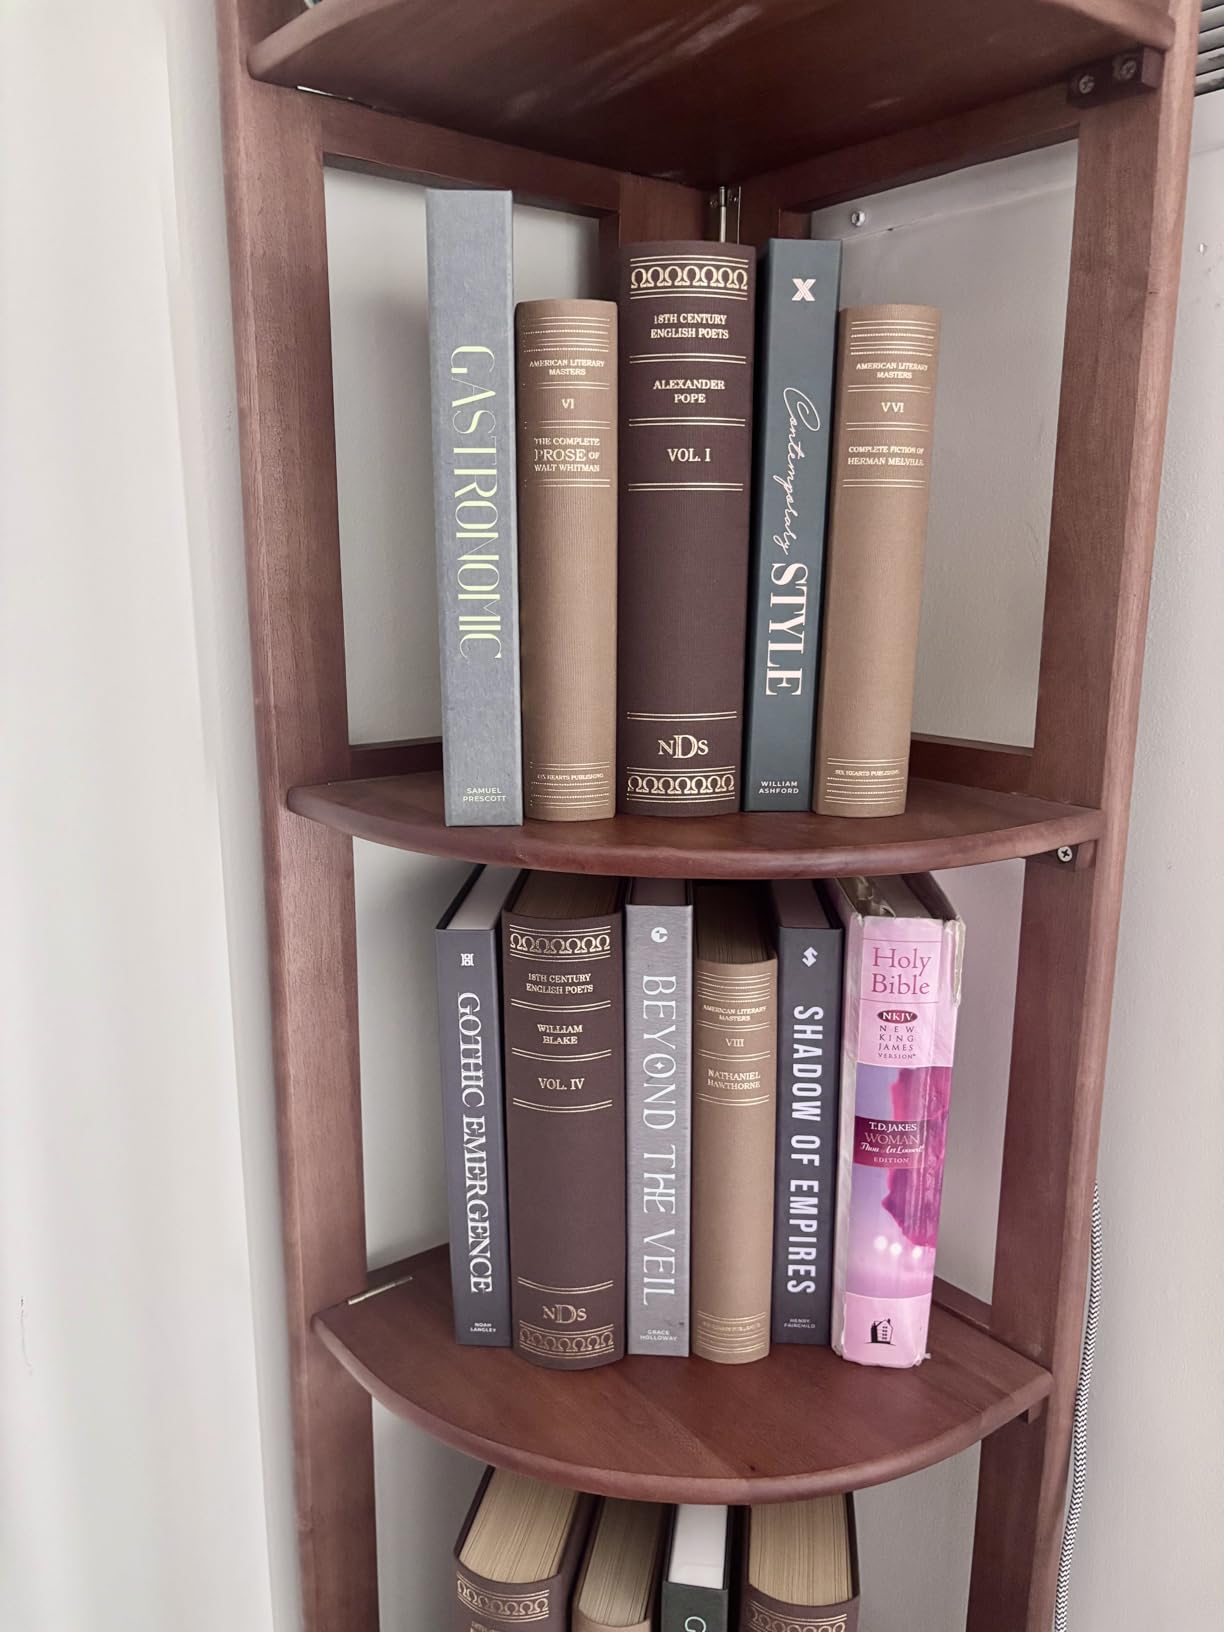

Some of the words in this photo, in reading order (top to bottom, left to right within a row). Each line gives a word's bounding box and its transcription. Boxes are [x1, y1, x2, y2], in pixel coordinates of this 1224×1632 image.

[653, 313, 678, 325] 18TH
[679, 313, 727, 325] CENTURY
[650, 328, 696, 339] ENGLISH
[698, 328, 729, 339] POETS
[529, 359, 568, 367] AMERICAN
[570, 359, 605, 367] LITERARY
[856, 362, 896, 370] AMERICAN
[548, 368, 587, 376] MASTERS
[653, 379, 725, 390] ALEXANDER
[561, 398, 575, 409] VI
[674, 393, 706, 404] POPE
[534, 437, 551, 446] THE
[552, 437, 601, 446] COMPLETE
[534, 448, 586, 462] PROSE
[588, 451, 600, 460] OF
[667, 448, 701, 462] VOL.
[705, 448, 711, 462] I
[889, 446, 916, 454] FICTION
[847, 457, 886, 465] HERMAN
[534, 463, 558, 472] WALT
[558, 463, 600, 472] WHITMAN
[771, 386, 821, 556] Contemporary
[450, 345, 502, 660] GASTRONOMIC
[765, 562, 809, 696] STYLE
[871, 947, 932, 978] Holy
[528, 973, 547, 983] 18TH
[549, 973, 591, 983] CENTURY
[526, 982, 563, 994] ENGLISH
[564, 984, 594, 994] POETS
[871, 973, 931, 996] Bible
[703, 1004, 736, 1015] AMERICAN
[736, 1006, 767, 1015] LITERARY
[718, 1014, 751, 1022] MASTERS
[882, 1012, 914, 1022] NKJV
[537, 1023, 583, 1034] WILLIAM
[879, 1025, 915, 1033] NEW
[542, 1035, 578, 1044] BLAKE
[725, 1037, 745, 1047] VIII
[879, 1034, 914, 1042] KING
[457, 991, 485, 1108] GOTHIC
[642, 975, 677, 1130] BEYOND
[878, 1043, 914, 1051] JAMES
[791, 1005, 824, 1122] SHADOW
[707, 1068, 761, 1081] NATHANIEL
[537, 1077, 568, 1091] VOL.
[570, 1077, 585, 1091] IV
[707, 1078, 761, 1090] HAWTHORNE
[887, 1123, 918, 1133] JAKES
[864, 1132, 921, 1145] WOMAN
[790, 1135, 821, 1167] OF
[873, 1156, 911, 1164] EDITION
[642, 1145, 677, 1214] THE
[462, 1113, 493, 1295] EMERGENCE
[787, 1179, 819, 1295] EMPIRES
[642, 1228, 677, 1306] VEIL
